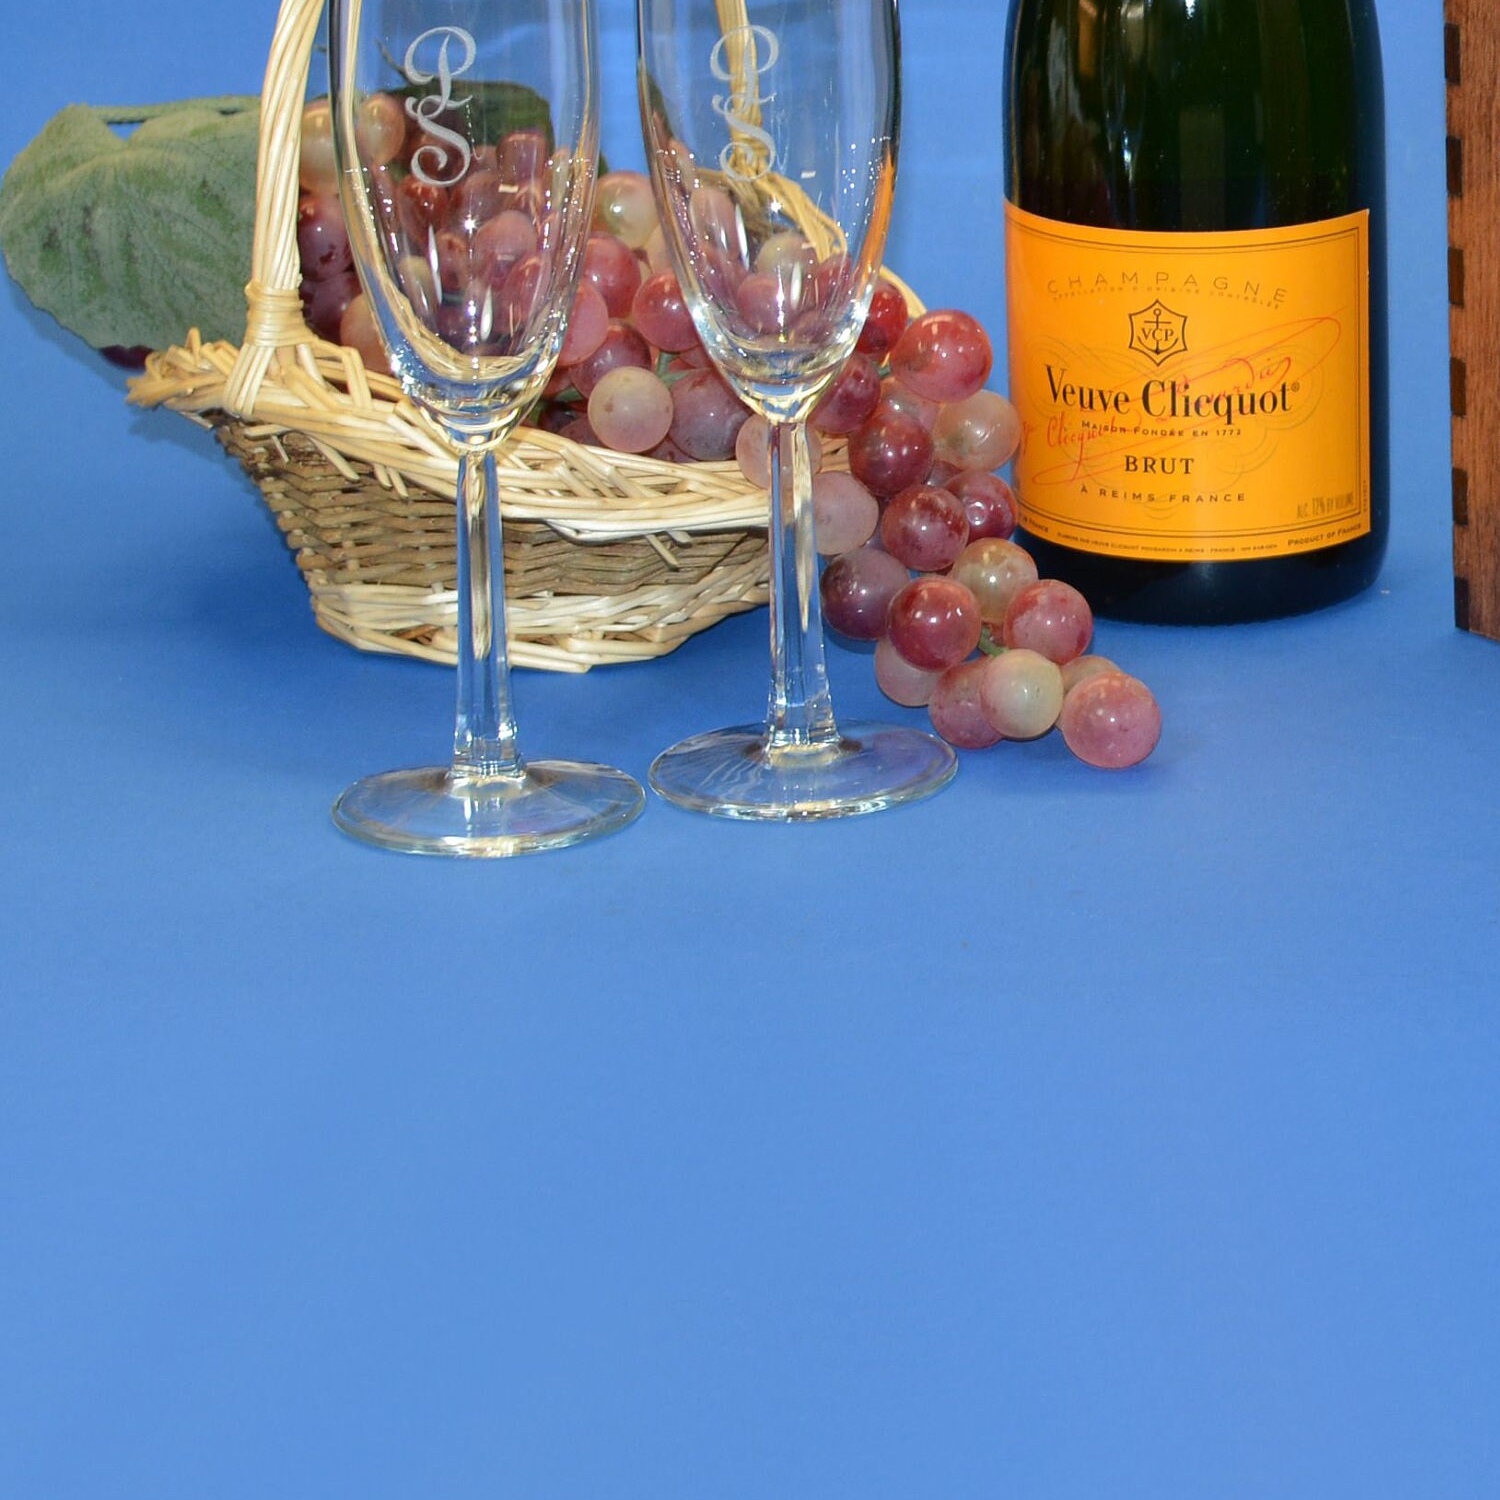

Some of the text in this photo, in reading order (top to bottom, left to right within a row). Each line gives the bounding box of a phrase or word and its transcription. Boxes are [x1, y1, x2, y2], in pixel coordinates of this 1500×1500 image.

[1047, 271, 1288, 304] CHAMPAGNE
[1141, 327, 1175, 342] VCP
[1044, 363, 1131, 416] Veuve
[1192, 429, 1209, 437] EN
[1216, 428, 1242, 437] 1772
[1124, 454, 1195, 475] BRUT
[1100, 489, 1156, 502] REIMS
[1169, 492, 1246, 503] FRANCE
